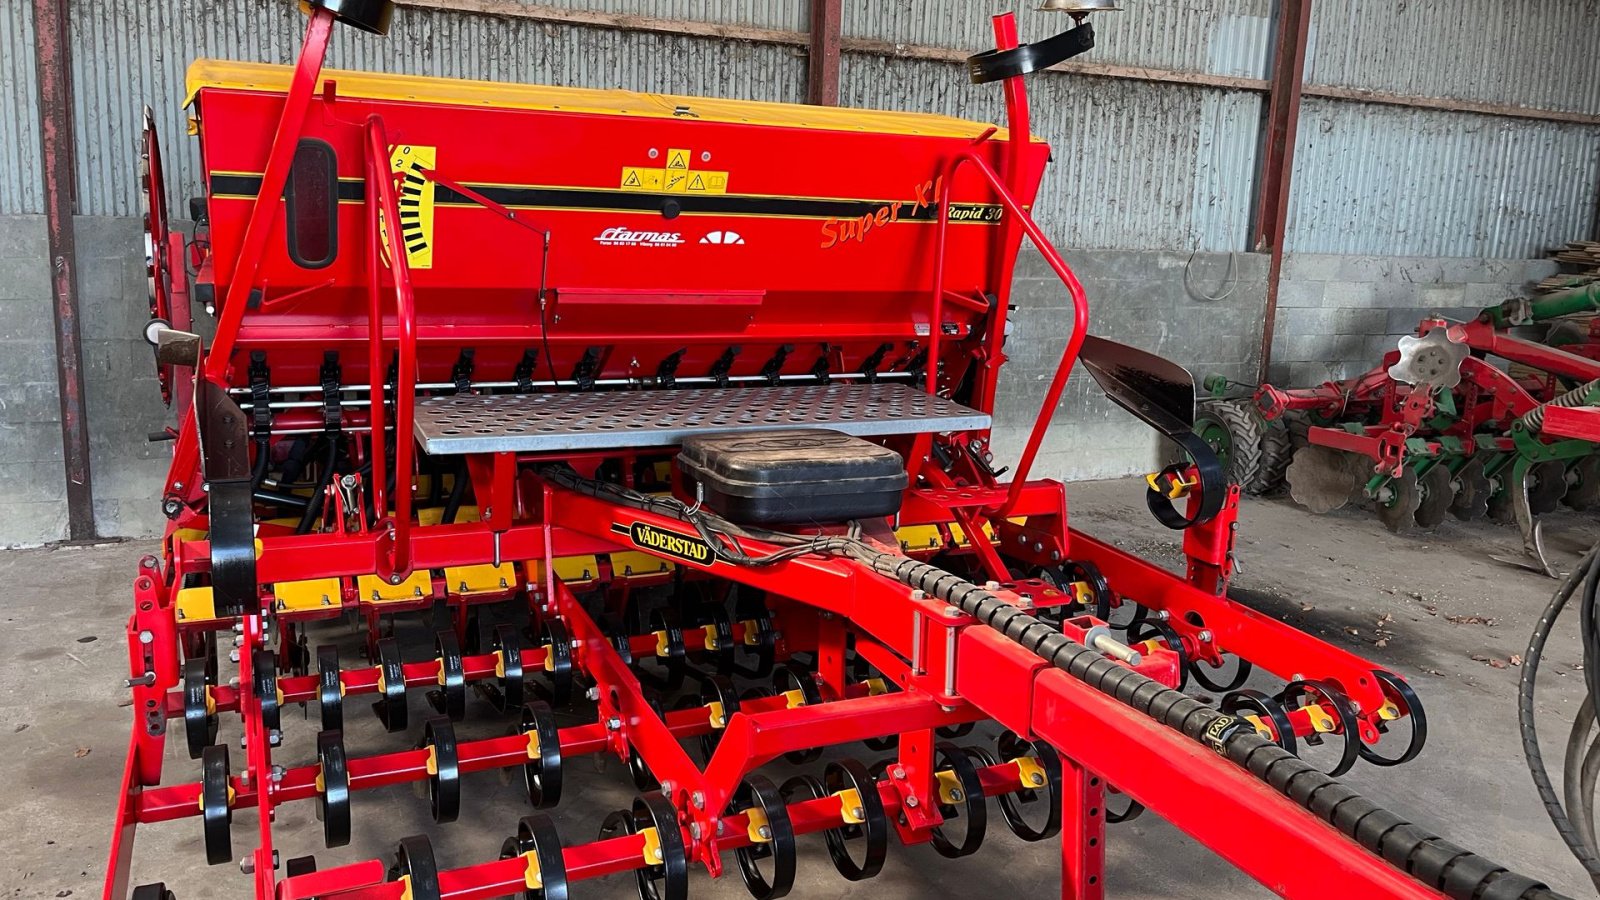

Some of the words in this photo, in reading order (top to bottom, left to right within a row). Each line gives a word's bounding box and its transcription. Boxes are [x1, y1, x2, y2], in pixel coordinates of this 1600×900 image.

[403, 146, 411, 155] 0
[395, 159, 404, 168] 2
[948, 206, 984, 220] Rapid
[820, 201, 903, 249] Super
[636, 526, 708, 561] VÄDERSTAD
